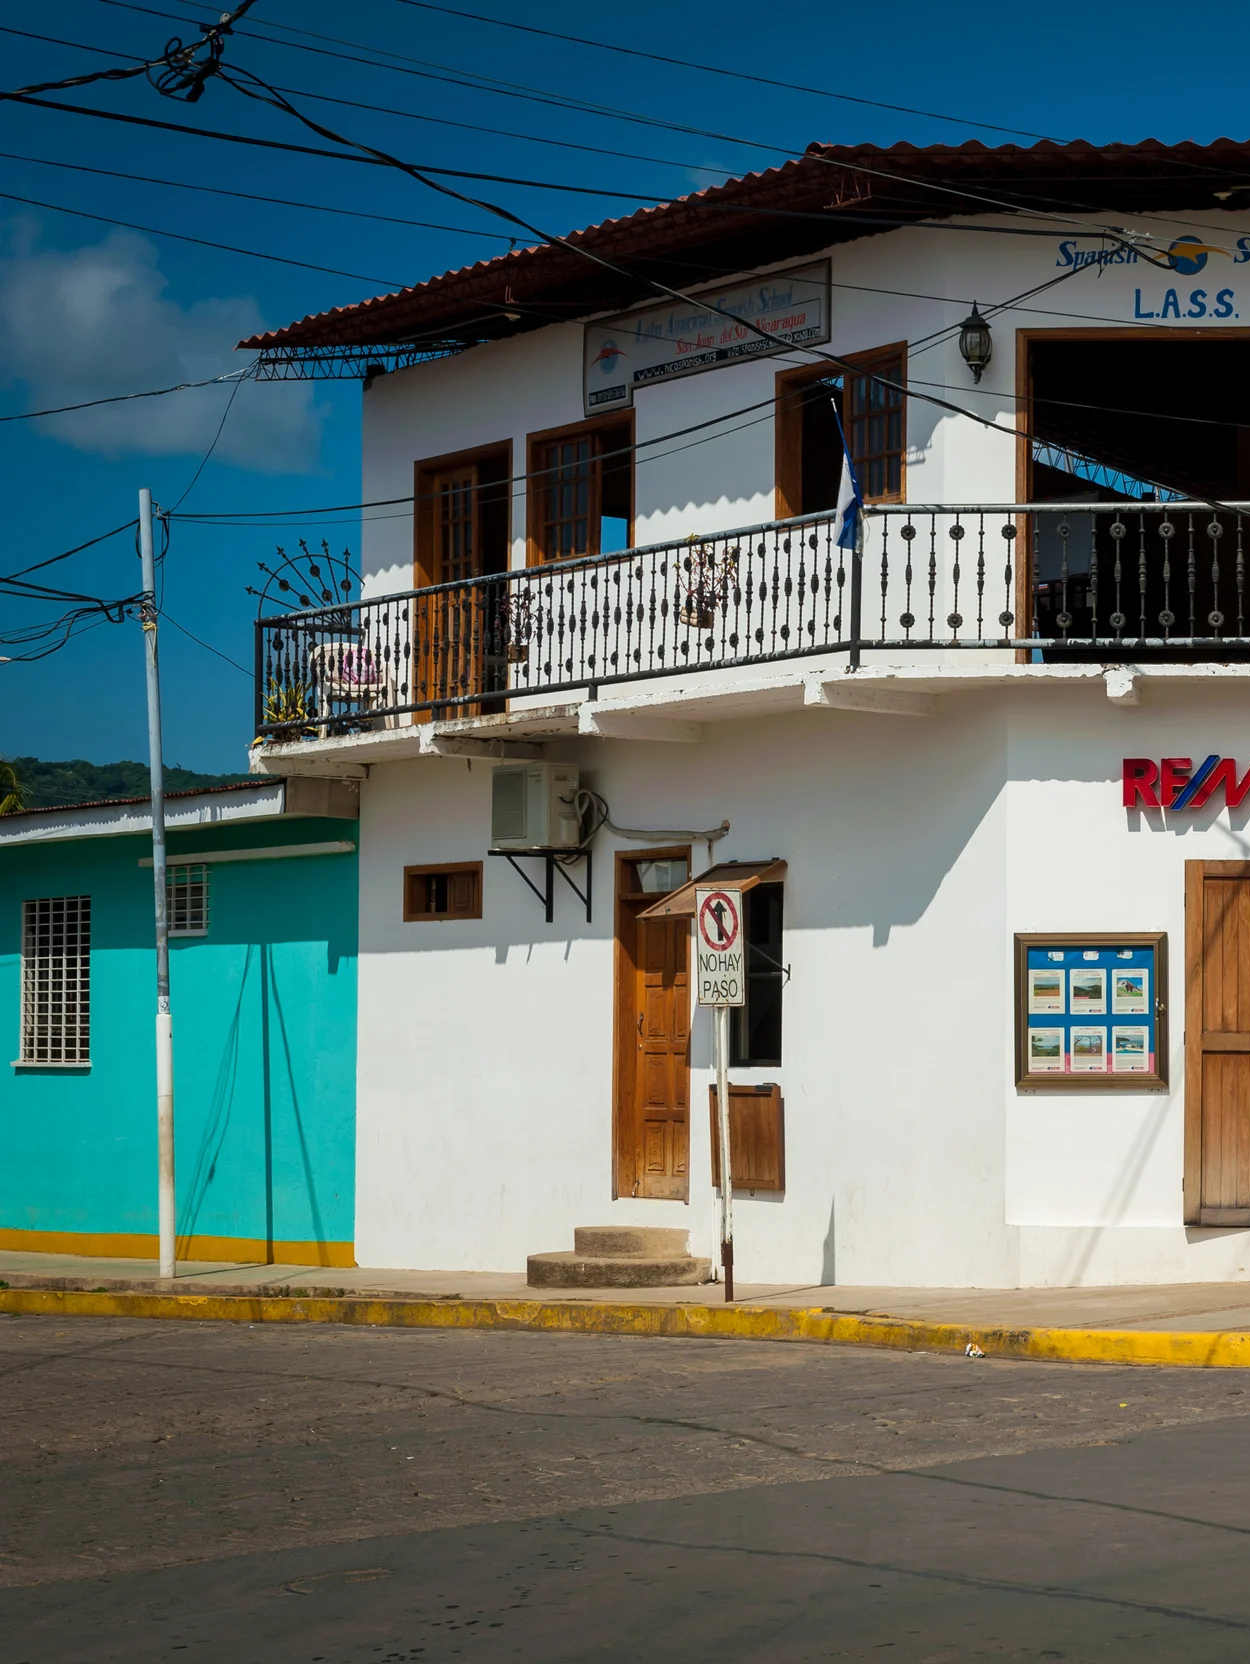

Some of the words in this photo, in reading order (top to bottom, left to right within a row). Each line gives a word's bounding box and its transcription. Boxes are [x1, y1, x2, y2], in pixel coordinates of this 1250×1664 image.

[1056, 240, 1138, 270] Spanish
[758, 284, 794, 312] School
[1134, 288, 1240, 319] L.A.S.S.
[675, 338, 692, 355] San
[693, 333, 715, 350] Juan
[720, 326, 733, 344] del
[733, 324, 749, 340] Sur
[703, 979, 738, 998] PASO
